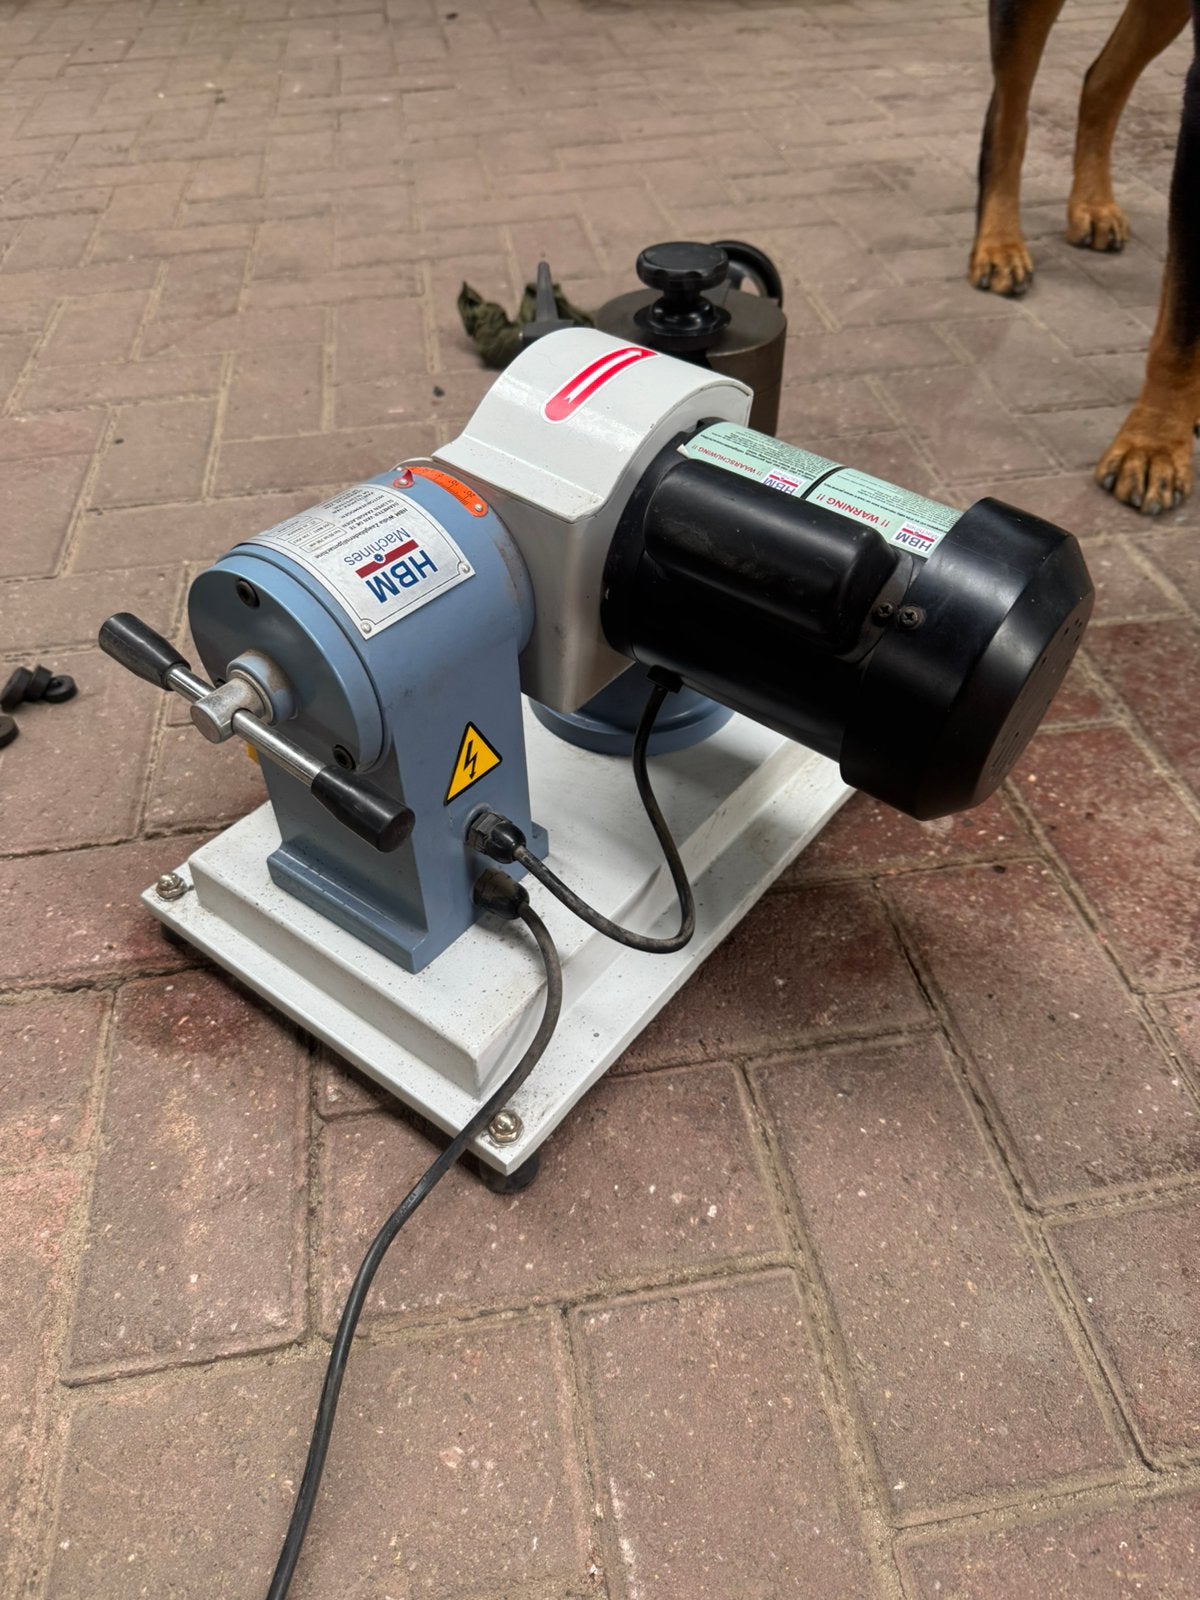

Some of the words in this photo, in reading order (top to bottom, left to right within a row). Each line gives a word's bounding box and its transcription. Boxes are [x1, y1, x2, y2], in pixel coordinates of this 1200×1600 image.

[698, 446, 756, 473] WAARSCHUWING
[763, 478, 796, 494] HBM
[374, 502, 400, 516] DIAMETER
[394, 508, 408, 517] HBM
[826, 497, 880, 524] WARNING
[344, 527, 411, 566] Machines
[895, 531, 932, 552] HBM
[365, 549, 438, 603] HBM
